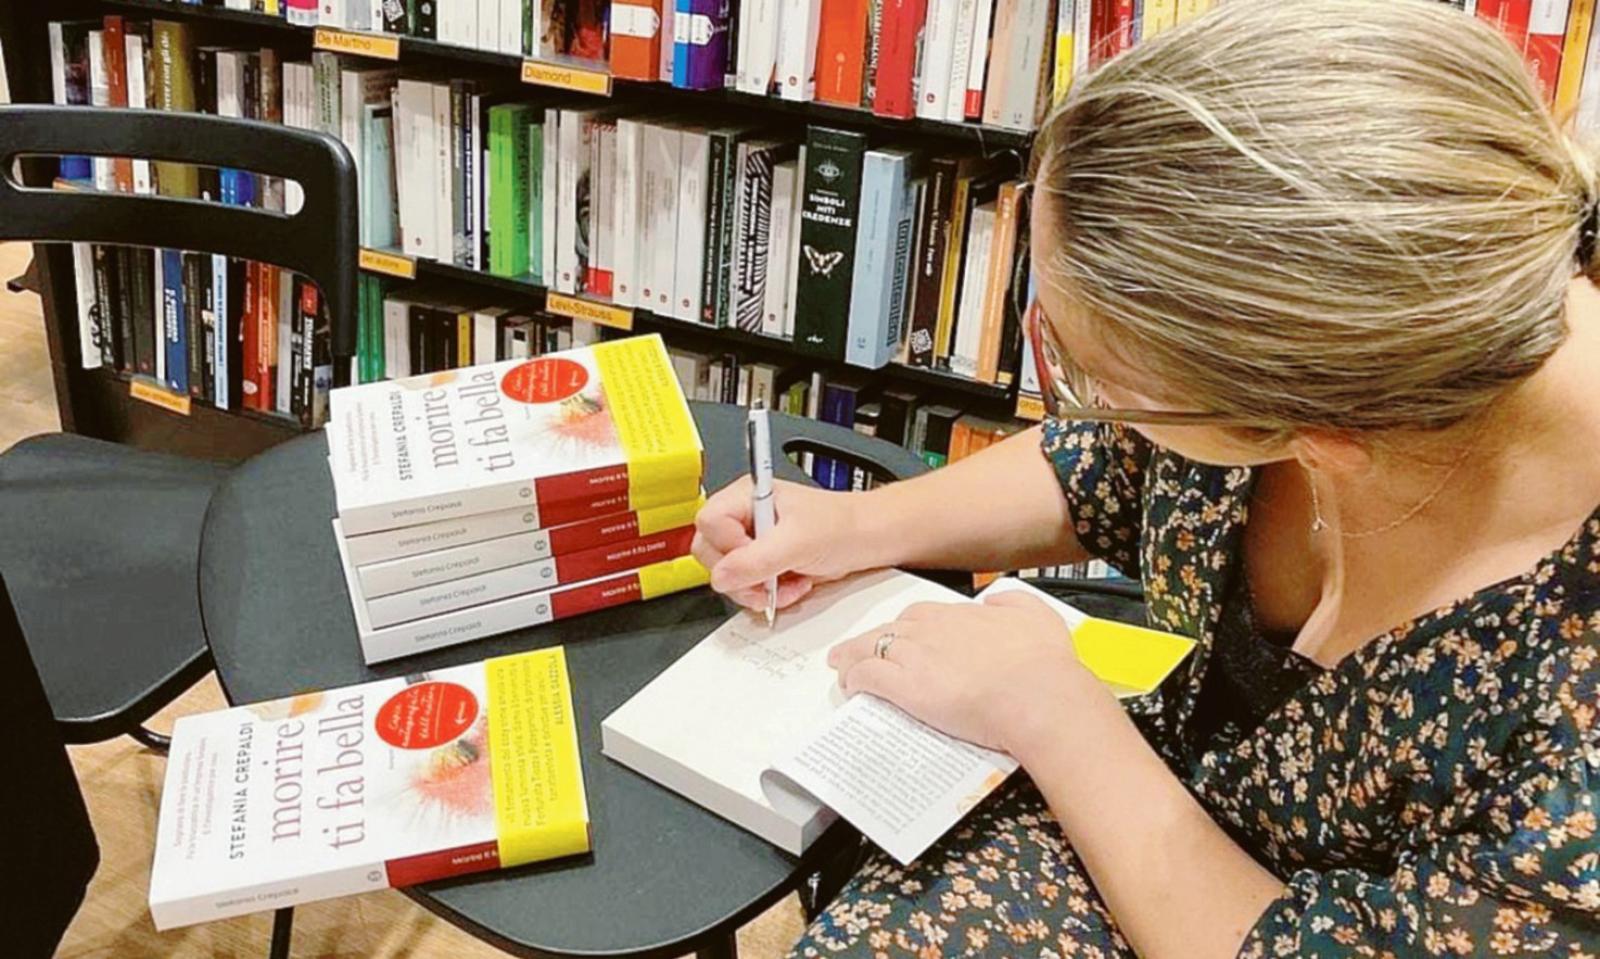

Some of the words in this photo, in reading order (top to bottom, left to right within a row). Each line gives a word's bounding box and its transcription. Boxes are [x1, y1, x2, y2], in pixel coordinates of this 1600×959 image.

[317, 32, 331, 44] De
[333, 35, 371, 49] Martino
[525, 66, 571, 84] Diamond
[802, 210, 852, 228] CREDENZE
[809, 193, 846, 208] SIMBOLI
[389, 390, 407, 433] CREPALDI
[457, 370, 505, 425] bella
[415, 389, 460, 469] morire
[467, 423, 511, 448] fa
[395, 435, 413, 480] STEFANIA
[477, 451, 515, 473] ti
[234, 721, 254, 784] CREPALDI
[316, 694, 366, 776] bella
[262, 717, 305, 843] morire
[316, 776, 366, 810] fa
[229, 787, 249, 860] STEFANIA
[321, 821, 366, 850] ti
